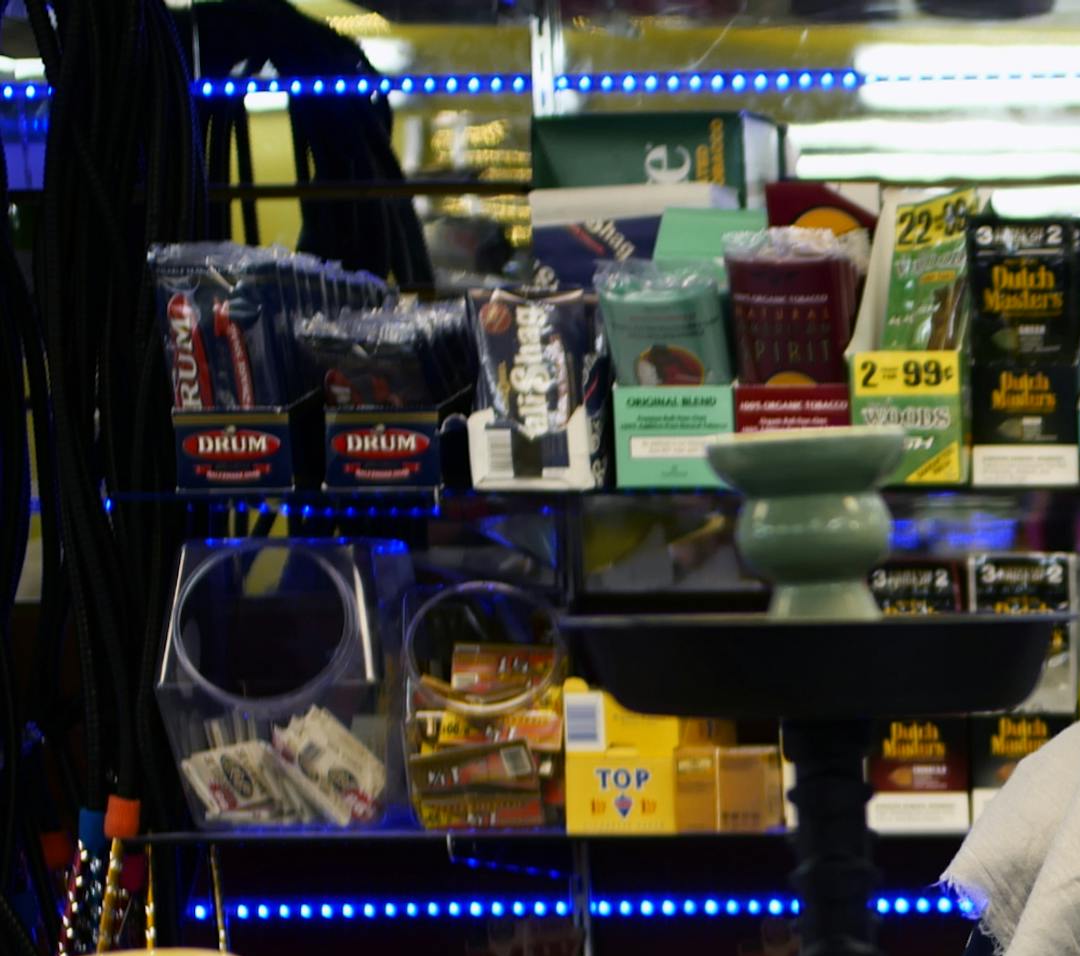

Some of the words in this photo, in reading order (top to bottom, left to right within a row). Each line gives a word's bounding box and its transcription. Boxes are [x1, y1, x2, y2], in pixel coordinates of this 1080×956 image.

[976, 226, 993, 245] 3
[1046, 225, 1063, 244] 2
[992, 264, 1055, 290] Dutch
[984, 286, 1063, 312] Masters
[170, 311, 203, 410] RUM
[861, 360, 878, 388] 2
[903, 359, 954, 388] 99¢
[1001, 370, 1051, 392] Dutch
[627, 396, 677, 408] ORIGINAL
[681, 395, 717, 407] BLEND
[763, 400, 803, 411] ORGANIC
[805, 399, 849, 411] TOBACCO
[992, 389, 1057, 412] Masters
[862, 405, 951, 430] WOODS
[197, 434, 268, 453] DRUM
[346, 433, 417, 452] DRUM
[872, 568, 886, 589] 3
[934, 568, 949, 588] 2
[981, 563, 996, 584] 3
[1047, 563, 1064, 584] 2
[890, 720, 939, 741] Dutch
[997, 716, 1048, 738] Dutch
[882, 737, 946, 758] Masters
[595, 767, 651, 790] TOP
